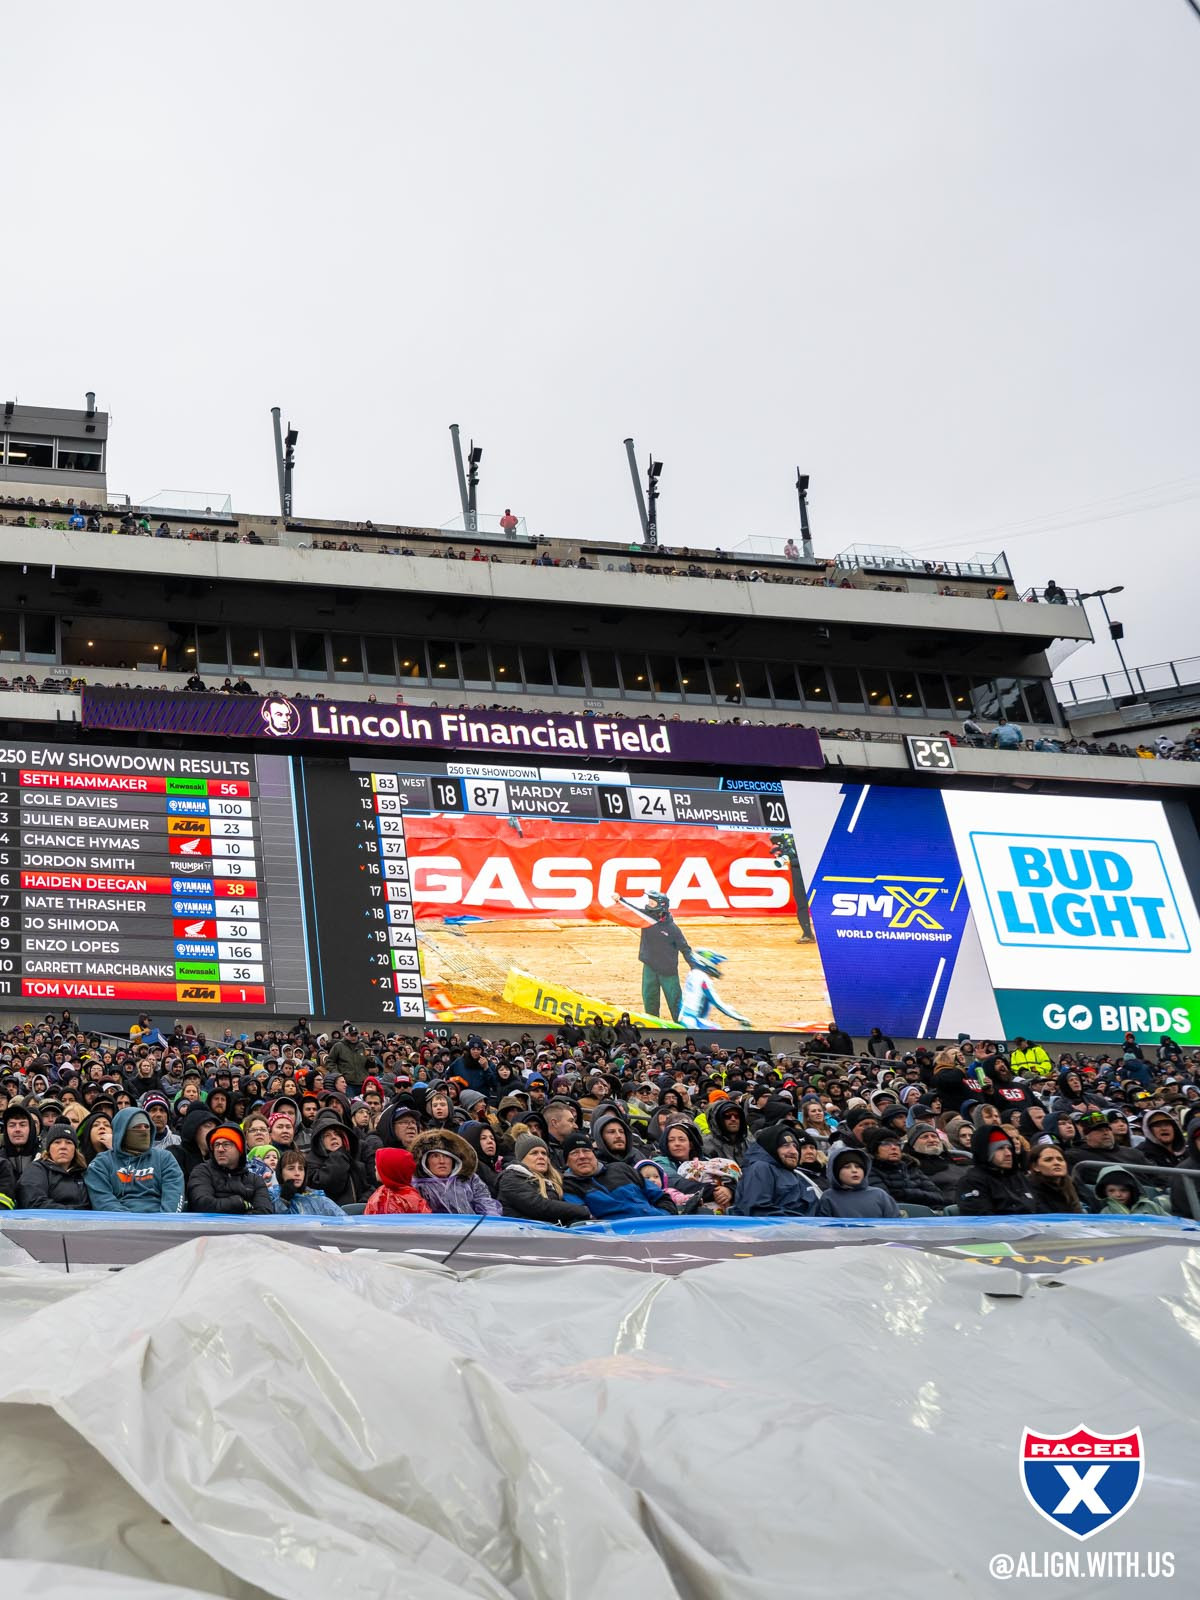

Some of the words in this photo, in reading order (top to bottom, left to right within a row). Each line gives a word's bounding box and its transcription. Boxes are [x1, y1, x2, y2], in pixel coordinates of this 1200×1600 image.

[311, 706, 432, 740] Lincoln
[441, 713, 587, 750] Financial
[593, 724, 671, 754] Field
[31, 750, 65, 767] E/W
[68, 753, 175, 772] SHOWDOWN
[180, 759, 250, 775] RESULTS
[916, 740, 950, 767] 25
[449, 765, 464, 774] 250
[466, 767, 481, 775] EW
[482, 768, 537, 778] SHOWDOWN
[571, 772, 600, 782] 12:26
[0, 773, 7, 783] 1
[23, 774, 59, 787] SETH
[64, 776, 148, 791] HAMMAKER
[169, 782, 204, 791] Kawasaki
[220, 784, 238, 795] 56
[358, 777, 370, 789] 12
[379, 778, 395, 789] 83
[402, 778, 425, 787] WEST
[570, 787, 593, 796] EAST
[726, 779, 783, 792] SUPERCROSS
[438, 785, 457, 806] 18
[474, 788, 499, 807] 87
[509, 786, 562, 799] HARDY
[674, 794, 691, 807] RJ
[732, 795, 755, 804] EAST
[0, 793, 9, 803] 2
[23, 794, 62, 807] COLE
[66, 796, 119, 809] DAVIES
[177, 801, 207, 811] YAMAHA
[218, 804, 242, 815] 100
[361, 798, 372, 809] 13
[381, 799, 397, 810] 59
[511, 800, 571, 814] MUNOZ
[604, 793, 624, 815] 19
[639, 795, 667, 817] 24
[766, 802, 785, 823] 20
[0, 813, 9, 824] 3
[23, 813, 74, 826] JULIEN
[79, 816, 150, 830] BEAUMER
[172, 820, 206, 832] KTM
[223, 823, 240, 834] 23
[676, 807, 749, 823] HAMPSHIRE
[363, 820, 375, 830] 14
[383, 821, 399, 832] 92
[0, 833, 9, 844] 4
[24, 834, 85, 847] CHANCE
[89, 837, 140, 850] HYMAS
[225, 843, 240, 855] 10
[365, 841, 377, 852] 15
[385, 842, 401, 853] 37
[0, 853, 9, 864] 5
[24, 854, 87, 868] JORDON
[91, 856, 135, 870] SMITH
[170, 861, 204, 873] TRIUMPH
[226, 864, 242, 875] 19
[368, 863, 380, 874] 16
[388, 864, 404, 875] 93
[1008, 846, 1133, 891] BUD
[0, 875, 9, 885] 6
[25, 875, 82, 888] HAIDEN
[86, 878, 147, 891] DEEGAN
[181, 881, 212, 892] YAMAHA
[227, 884, 245, 895] 38
[370, 886, 381, 897] 17
[389, 886, 407, 898] 115
[408, 856, 791, 912] GASGAS
[0, 895, 9, 906] 7
[25, 896, 64, 909] NATE
[67, 898, 147, 912] THRASHER
[182, 902, 213, 913] YAMAHA
[230, 905, 245, 916] 41
[372, 908, 384, 920] 18
[393, 908, 409, 920] 87
[831, 885, 945, 930] SMX
[997, 890, 1166, 939] LIGHT
[0, 916, 9, 927] 8
[25, 917, 44, 929] JO
[48, 919, 120, 932] SHIMODA
[230, 926, 248, 937] 30
[836, 929, 874, 939] WORLD
[875, 930, 953, 942] CHAMPIONSHIP
[374, 931, 387, 942] 19
[395, 931, 412, 943] 24
[0, 938, 10, 949] 9
[25, 939, 68, 952] ENZO
[71, 941, 120, 954] LOPES
[185, 945, 216, 955] YAMAHA
[229, 946, 253, 958] 166
[377, 954, 389, 965] 20
[398, 954, 415, 966] 63
[25, 961, 83, 974] GARRETT
[86, 962, 175, 977] MARCHBANKS
[179, 967, 217, 976] Kawasaki
[233, 968, 251, 979] 36
[0, 982, 11, 993] 11
[25, 982, 60, 996] TOM
[63, 984, 115, 997] VIALLE
[181, 987, 216, 999] KTM
[240, 989, 247, 1001] 1
[379, 977, 392, 988] 21
[401, 978, 417, 990] 55
[382, 1001, 394, 1012] 22
[403, 1001, 420, 1013] 34
[1043, 1003, 1093, 1030] GO
[1100, 1005, 1191, 1033] BIRDS
